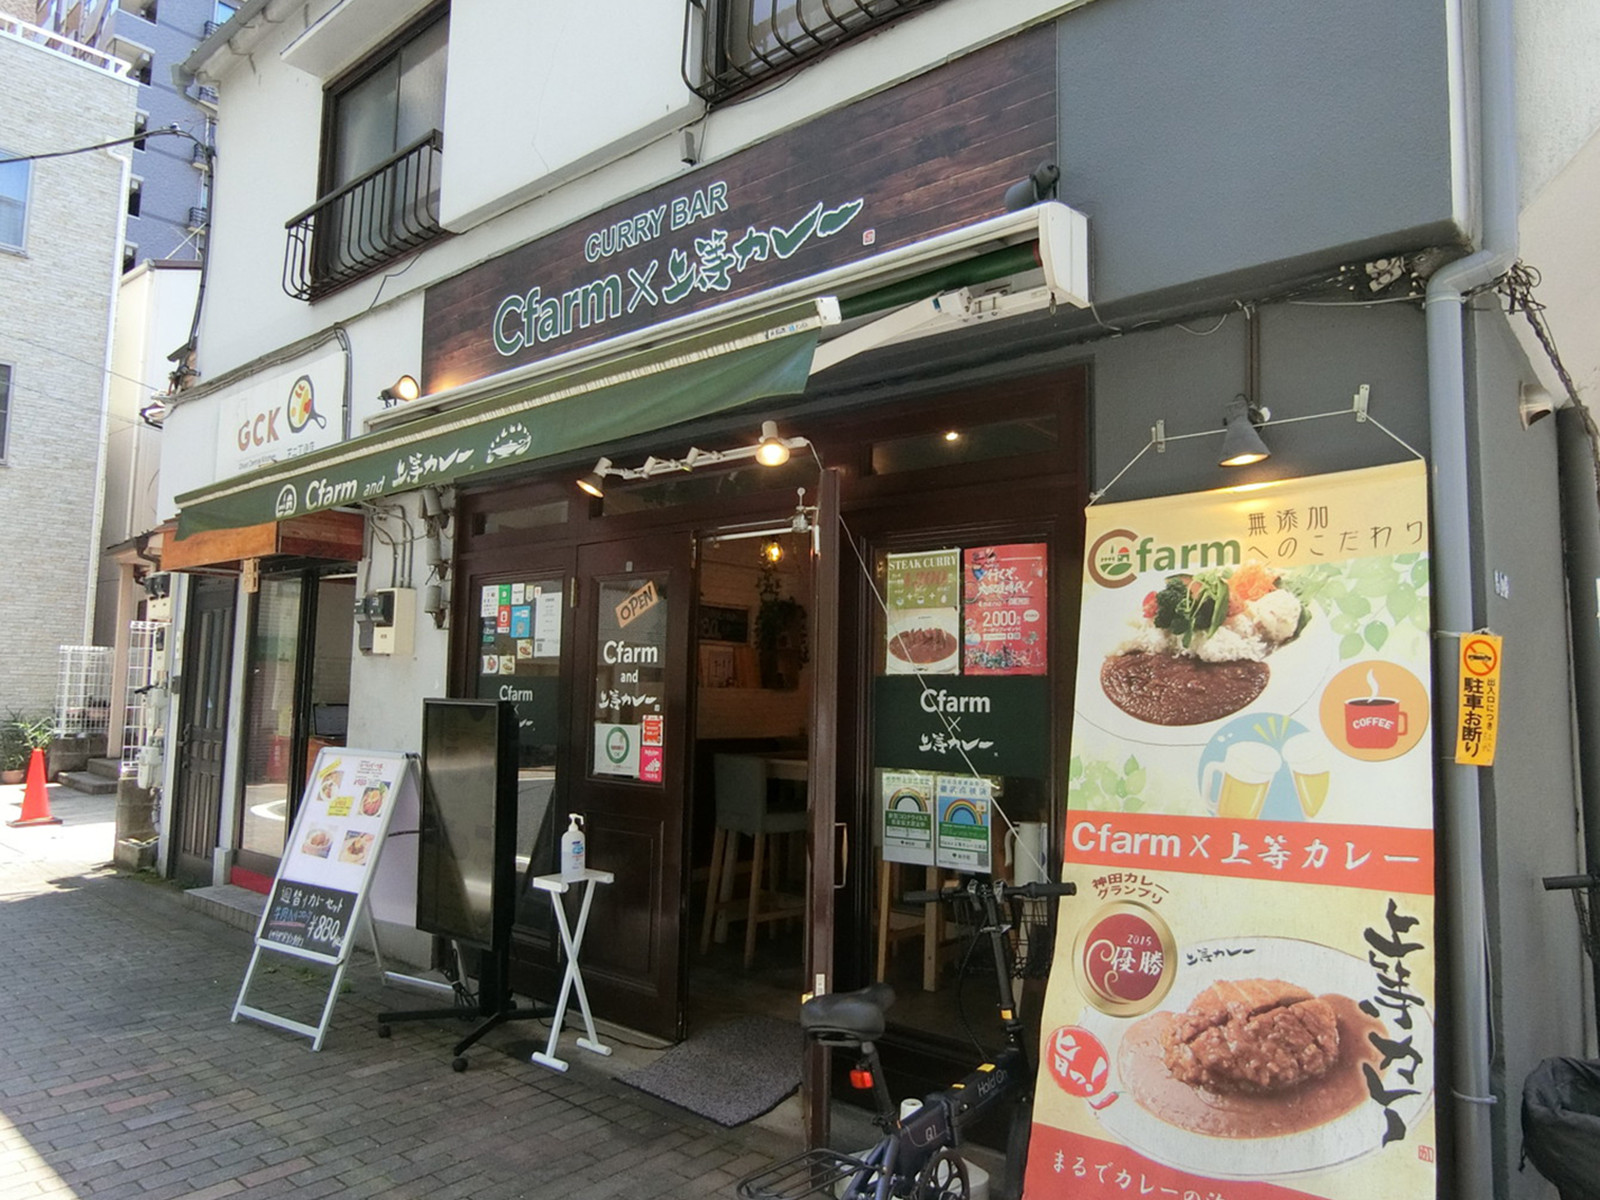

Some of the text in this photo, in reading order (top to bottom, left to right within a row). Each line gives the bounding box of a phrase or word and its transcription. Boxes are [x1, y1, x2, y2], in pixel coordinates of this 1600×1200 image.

[585, 180, 729, 263] CURRY BAR
[492, 274, 622, 357] Cfarm
[237, 406, 282, 452] GCK
[305, 479, 357, 510] Cfarm
[363, 475, 386, 496] and
[1247, 505, 1329, 537] 無添加
[1247, 520, 1423, 559] へのこだわり
[889, 555, 956, 571] STEAK CURRY
[620, 585, 654, 621] OPEN
[603, 640, 658, 664] Cfarm
[620, 669, 639, 684] and
[500, 684, 533, 702] Cfarm
[919, 688, 991, 713] Cfarm
[1352, 716, 1395, 731] COFFEE
[1462, 677, 1485, 758] 駐車お断り
[1071, 821, 1181, 858] Cfarm
[1219, 832, 1421, 871] 上等カレー
[1091, 872, 1170, 894] 神田カレー
[1097, 884, 1164, 905] グランプリ
[1127, 933, 1153, 947] 2015
[1110, 945, 1165, 976] 優勝
